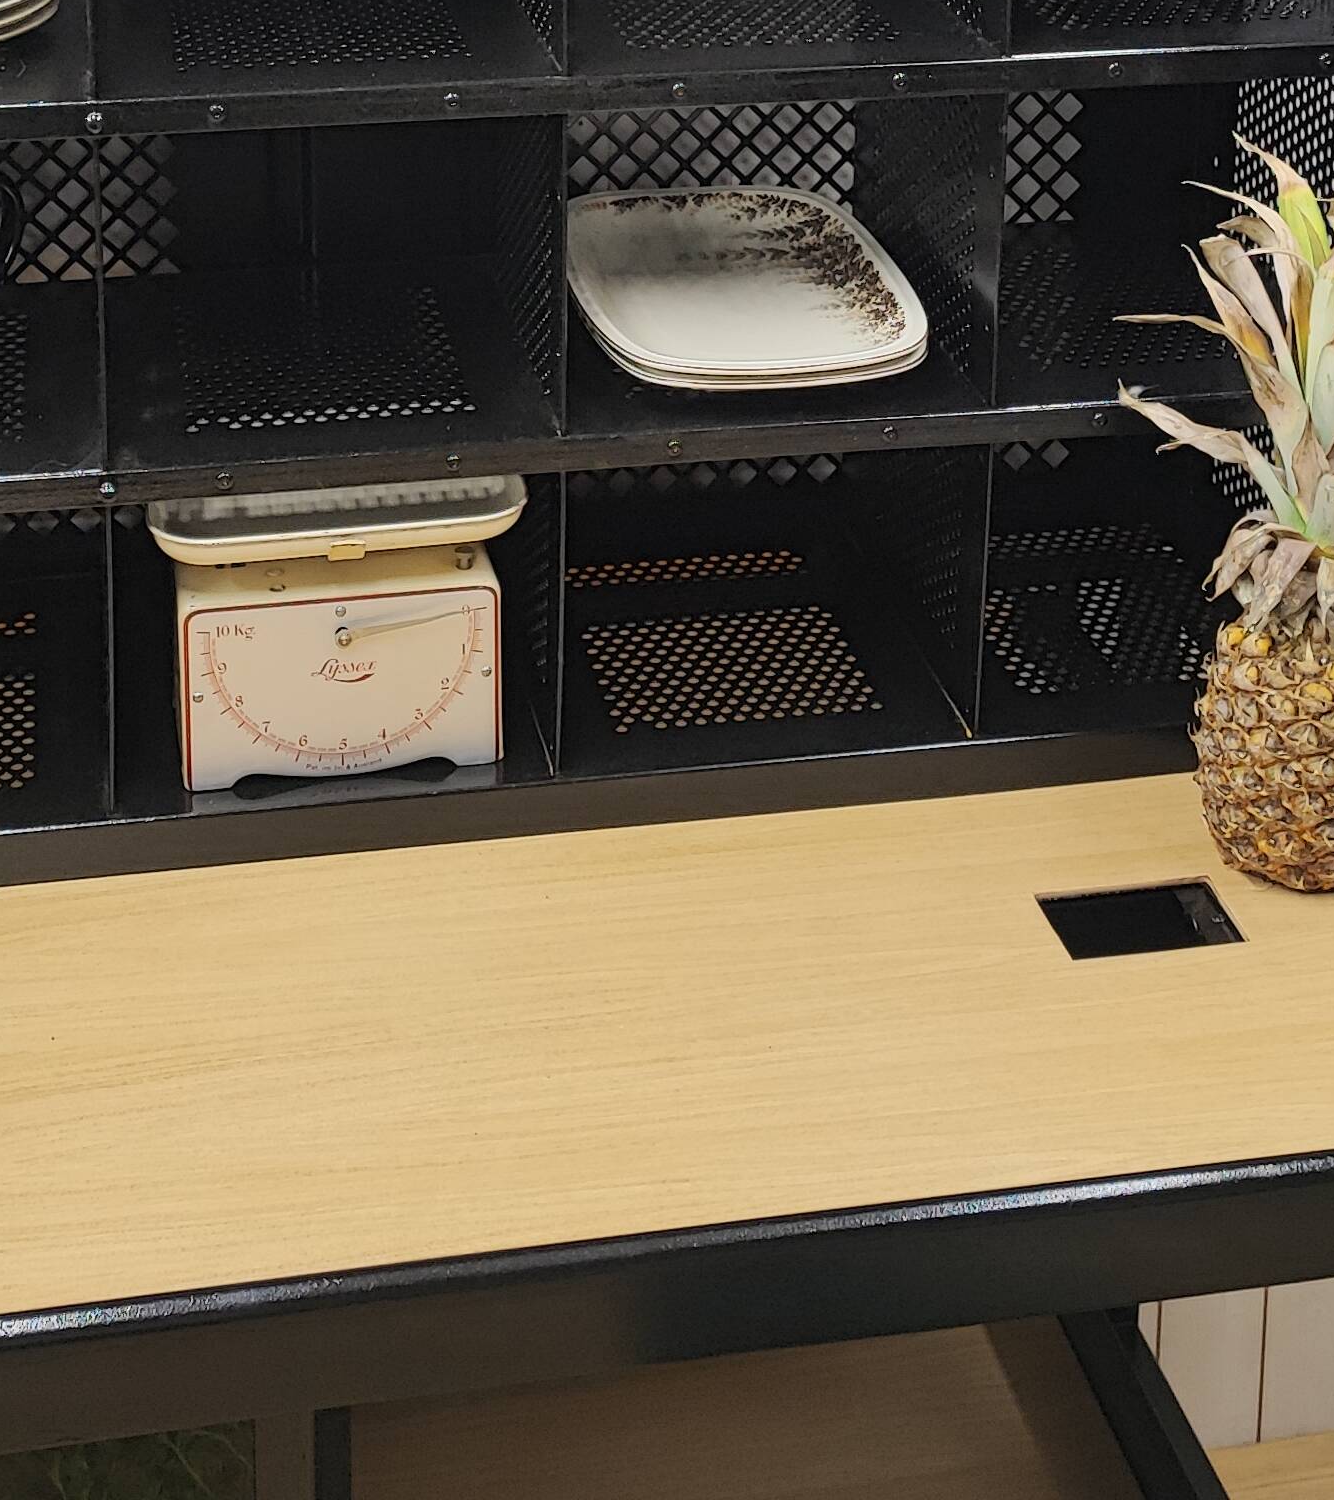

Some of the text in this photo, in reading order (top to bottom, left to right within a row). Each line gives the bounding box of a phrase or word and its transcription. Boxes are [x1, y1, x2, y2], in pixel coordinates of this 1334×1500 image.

[216, 626, 230, 638] 10
[461, 643, 466, 655] 1
[217, 662, 228, 674] 9
[441, 677, 450, 690] 2
[234, 695, 244, 707] 8
[414, 708, 424, 720] 3
[262, 721, 271, 733] 7
[378, 728, 387, 740] 4
[298, 735, 308, 747] 6
[338, 738, 348, 750] 5
